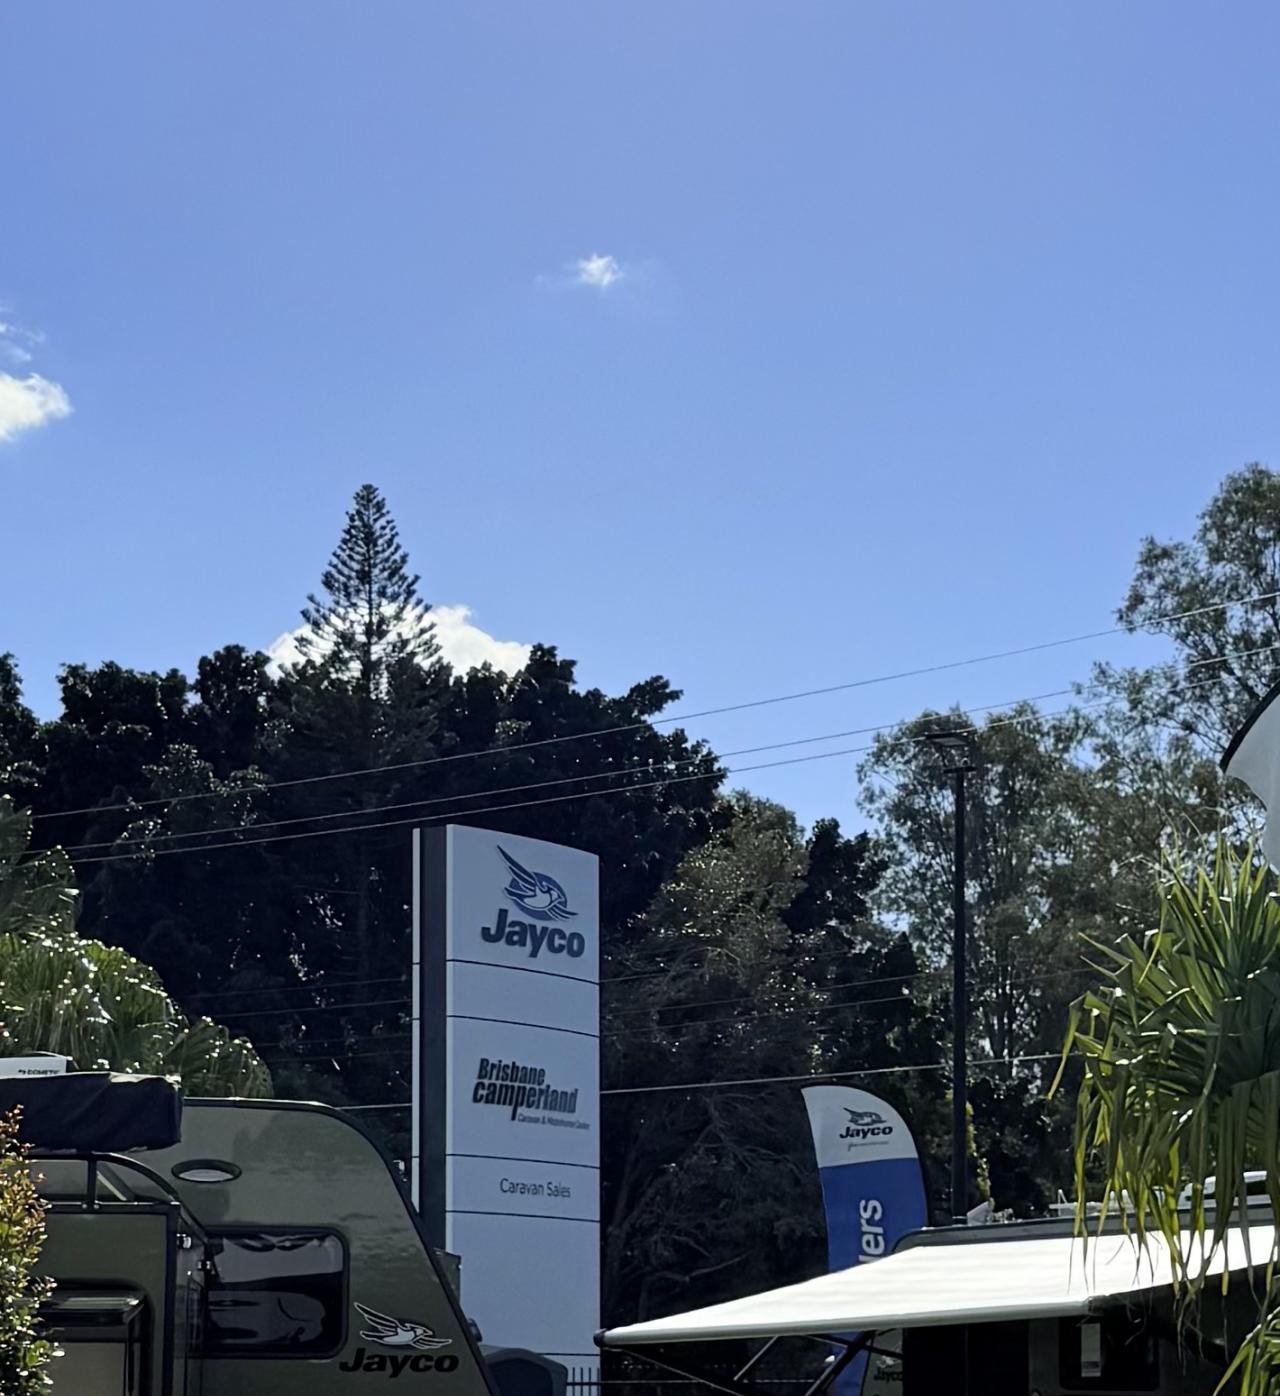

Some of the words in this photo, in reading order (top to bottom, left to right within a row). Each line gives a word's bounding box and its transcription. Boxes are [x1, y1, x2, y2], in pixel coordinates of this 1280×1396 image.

[481, 908, 585, 958] Jayco
[477, 1058, 546, 1086] Brisbane
[472, 1081, 579, 1121] camperland
[839, 1126, 893, 1140] Jayco
[500, 1178, 544, 1194] Caravan
[546, 1182, 571, 1198] Sales
[339, 1347, 459, 1379] Jayco
